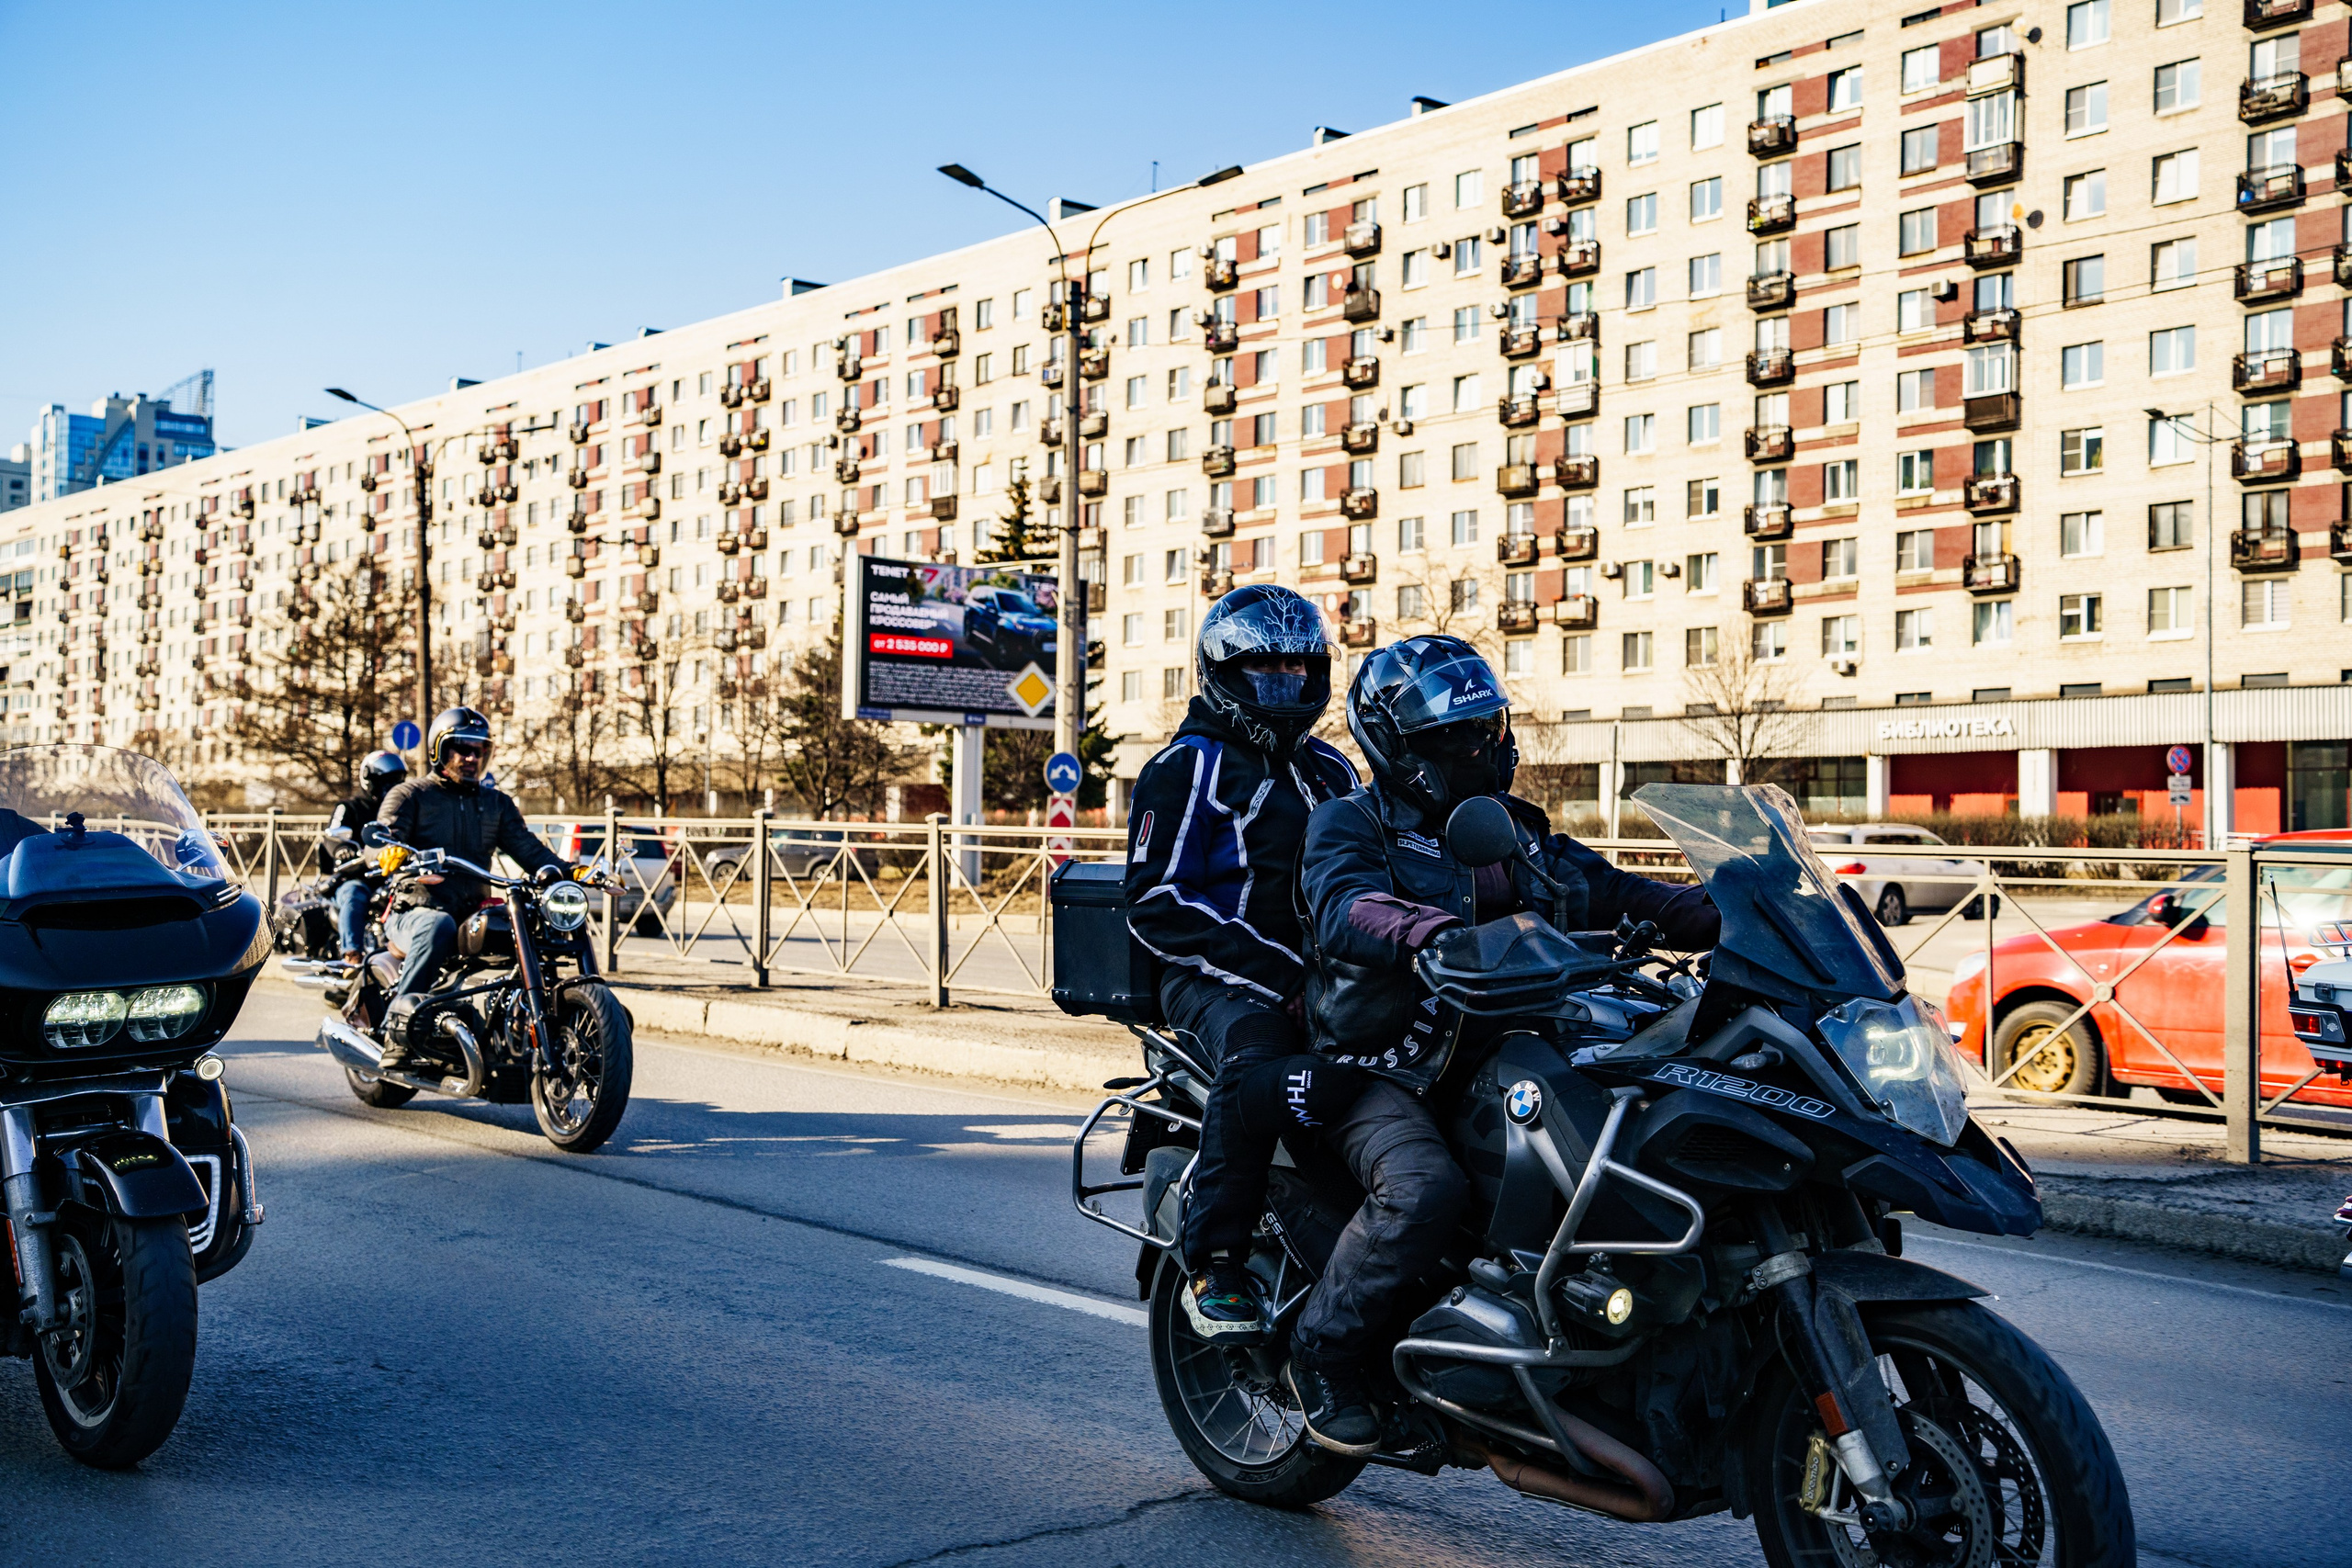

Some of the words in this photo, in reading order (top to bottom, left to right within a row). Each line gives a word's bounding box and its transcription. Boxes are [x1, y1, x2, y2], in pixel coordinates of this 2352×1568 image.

[870, 564, 910, 579] TENET
[913, 568, 939, 583] T7
[870, 591, 910, 604] САМЫЙ
[870, 603, 949, 619] ПРОДАВАЕМЫЙ
[874, 639, 886, 649] от
[887, 638, 895, 649] 2
[917, 640, 939, 652] 000
[1453, 689, 1493, 705] SHARK
[1878, 716, 2016, 739] БИБЛИОТЕКА
[1336, 996, 1440, 1068] RUSSIA
[1513, 1082, 1540, 1101] BMW
[1654, 1063, 1837, 1118] R1200
[1266, 1212, 1283, 1235] GS
[1278, 1235, 1303, 1269] ADVENTURE
[1805, 1456, 1819, 1499] brembo
